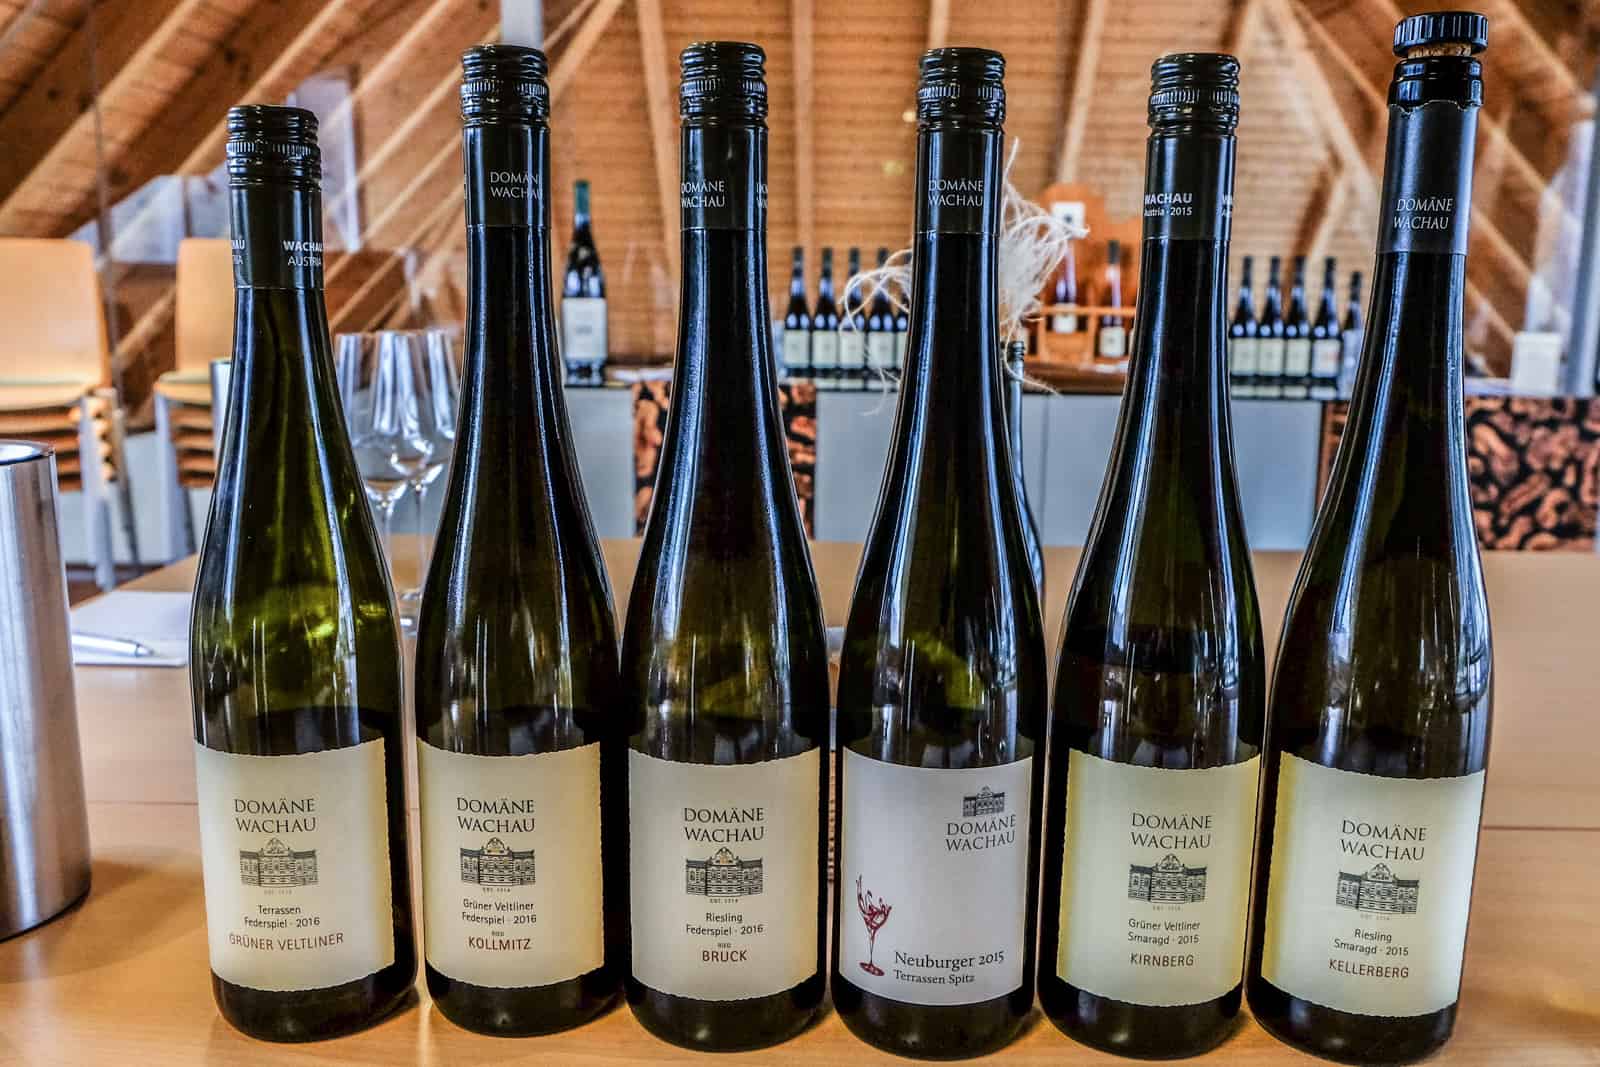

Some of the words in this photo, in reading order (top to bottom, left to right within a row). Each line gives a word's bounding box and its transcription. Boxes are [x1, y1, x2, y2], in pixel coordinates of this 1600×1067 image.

[928, 177, 984, 192] DOMÄNE
[928, 194, 984, 207] WACHAU
[1396, 196, 1454, 212] DOMÄNE
[1170, 207, 1193, 216] 2015
[1393, 216, 1449, 230] WACHAU
[234, 798, 316, 814] DOMÄNE
[456, 797, 535, 814] DOMÄNE
[684, 808, 765, 824] DOMÄNE
[1132, 813, 1212, 830] DOMÄNE
[236, 817, 317, 833] WACHAU
[457, 816, 535, 833] WACHAU
[946, 814, 1016, 836] DOMÄNE
[1342, 819, 1427, 841] DOMÄNE
[684, 826, 765, 843] WACHAU
[945, 830, 1016, 851] WACHAU
[1130, 832, 1211, 849] WACHAU
[1340, 839, 1425, 861] WACHAU
[258, 904, 301, 916] Terrassen
[463, 898, 492, 911] Grüner
[495, 901, 534, 912] Veltliner
[244, 917, 288, 931] Federspiel
[296, 917, 321, 929] 2016
[462, 911, 505, 926] Federspiel
[513, 914, 537, 924] 2016
[706, 912, 743, 924] Riesling
[1128, 918, 1161, 931] Grüner
[1164, 921, 1200, 932] Veltliner
[686, 924, 732, 937] Federspiel
[740, 924, 764, 935] 2016
[1354, 928, 1392, 943] Riesling
[229, 932, 274, 950] GRÜNER
[277, 932, 344, 951] VELTLINER
[468, 936, 532, 951] KOLLMITZ
[1128, 932, 1170, 946] Smaragd
[1178, 934, 1199, 944] 2015
[1334, 938, 1377, 955] Smaragd
[1385, 946, 1409, 956] 2015
[702, 950, 748, 963] BRUCK
[895, 951, 975, 972] Neuburger
[978, 951, 1004, 966] 2015
[1130, 953, 1194, 967] KIRNBERG
[1329, 958, 1409, 979] KELLERBERG
[894, 970, 946, 985] Terrassen
[948, 973, 975, 987] Spitz
